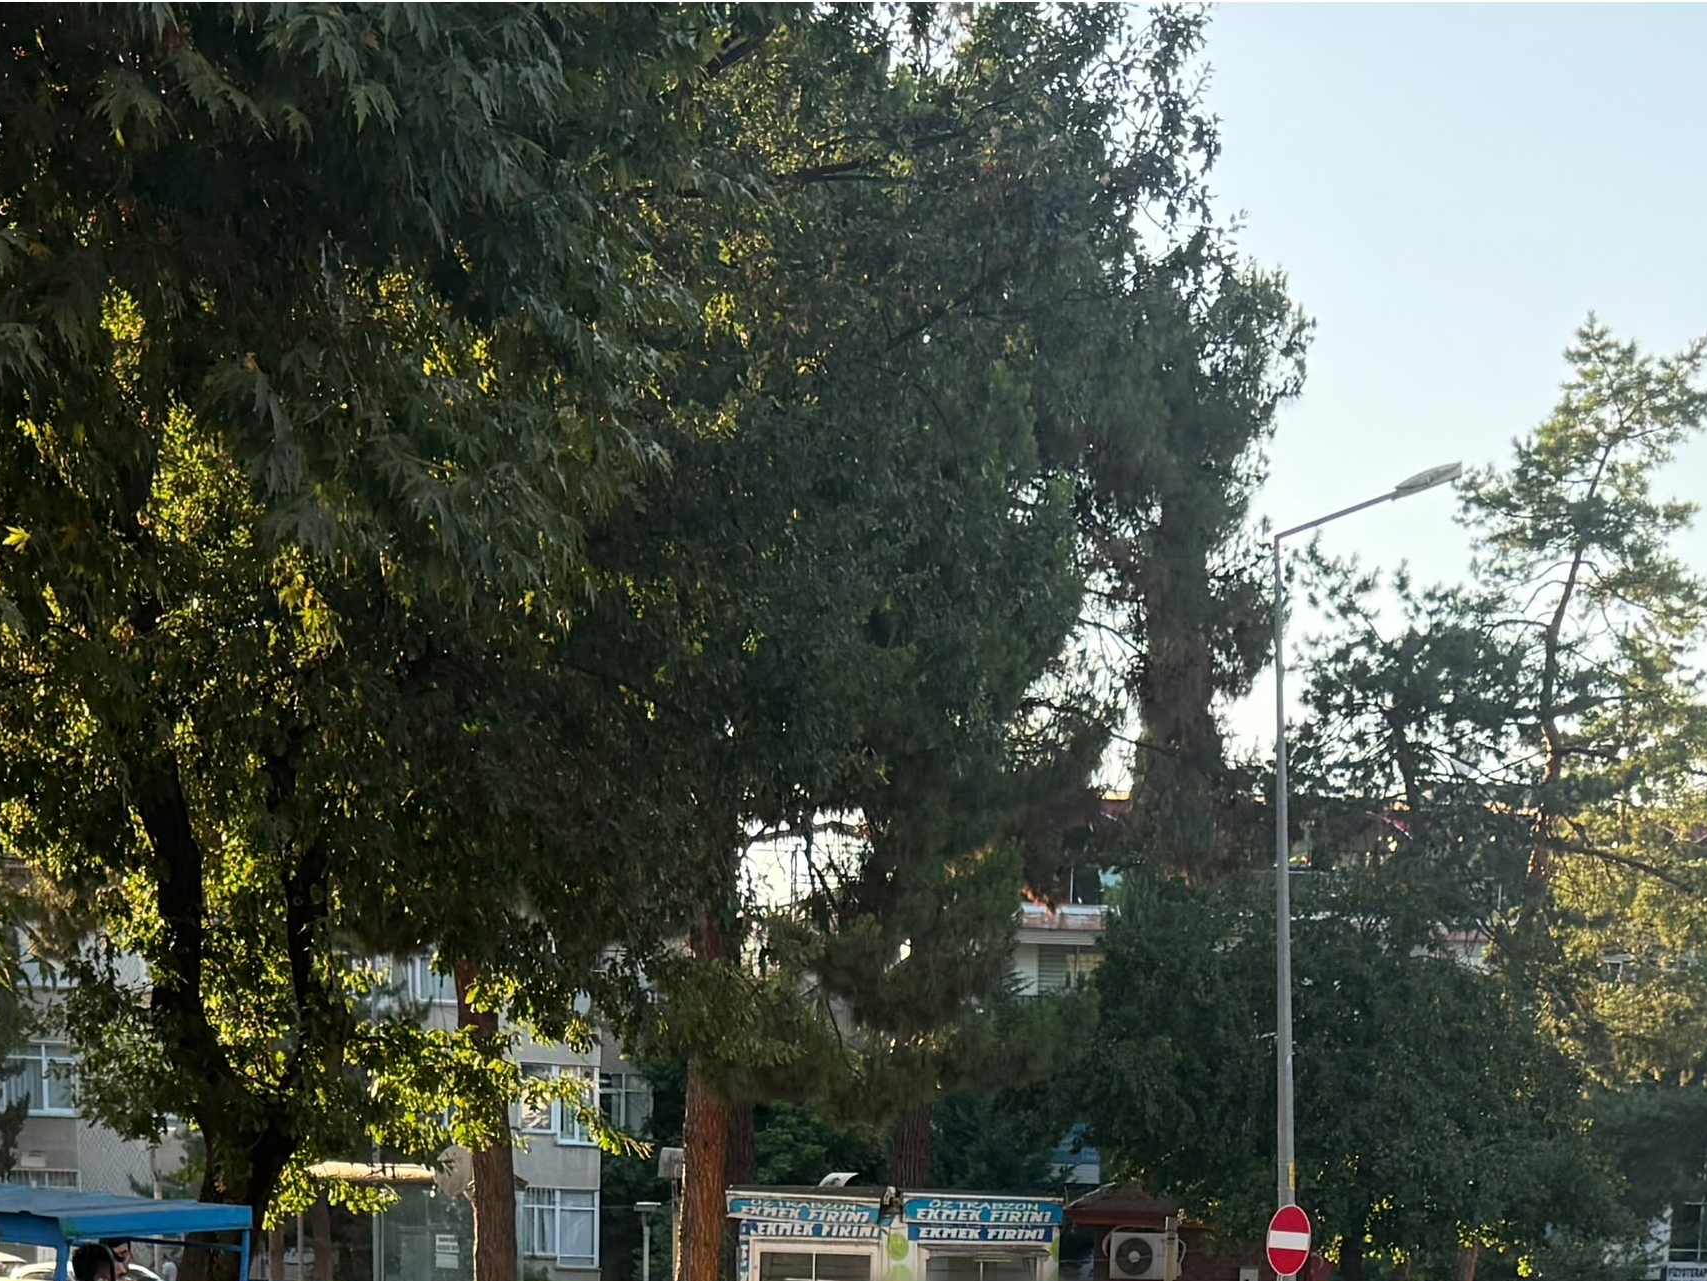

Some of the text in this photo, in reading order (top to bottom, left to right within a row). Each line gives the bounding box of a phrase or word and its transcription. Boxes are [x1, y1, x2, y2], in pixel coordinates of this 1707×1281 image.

[740, 1206, 800, 1219] EKMEK
[957, 1201, 1039, 1211] TRABZON
[916, 1208, 983, 1221] EKMEK
[757, 1222, 814, 1236] EKMEK
[919, 1227, 981, 1239] EKMEK
